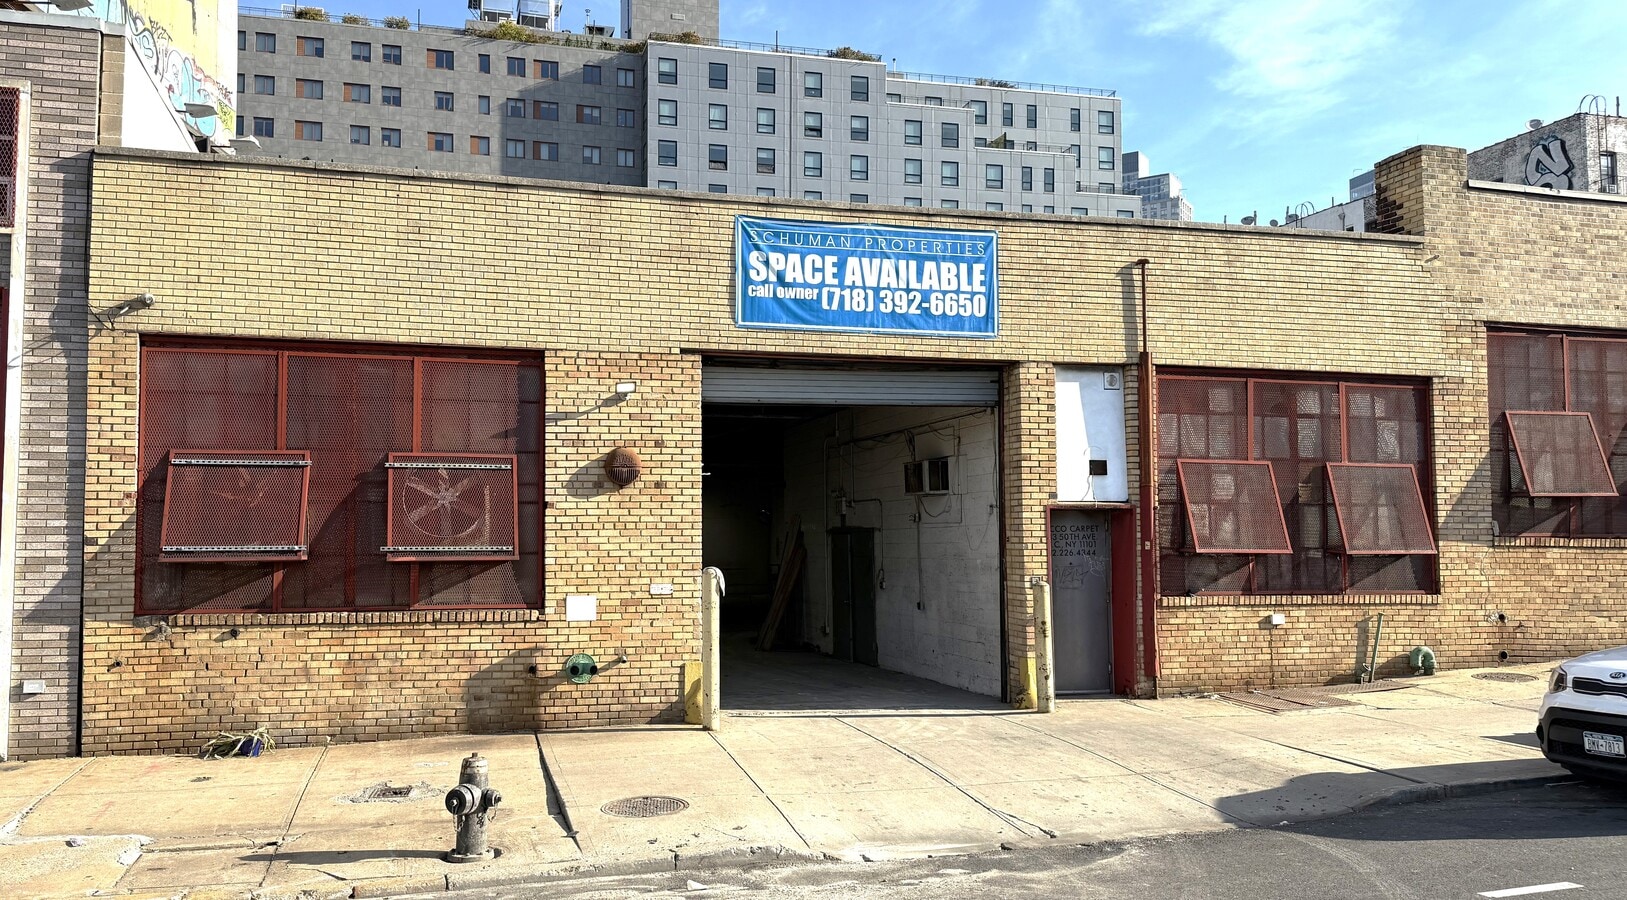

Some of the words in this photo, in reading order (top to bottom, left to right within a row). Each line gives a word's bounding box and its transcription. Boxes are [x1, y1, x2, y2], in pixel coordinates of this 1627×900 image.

[749, 230, 851, 249] SCHUMAN
[865, 237, 986, 256] PROPERTIES
[748, 250, 839, 286] SPACE
[844, 256, 986, 293] AVAILABLE
[747, 283, 774, 299] call
[776, 285, 819, 300] owner
[821, 286, 874, 312] (718)
[879, 289, 987, 318] 392-6650
